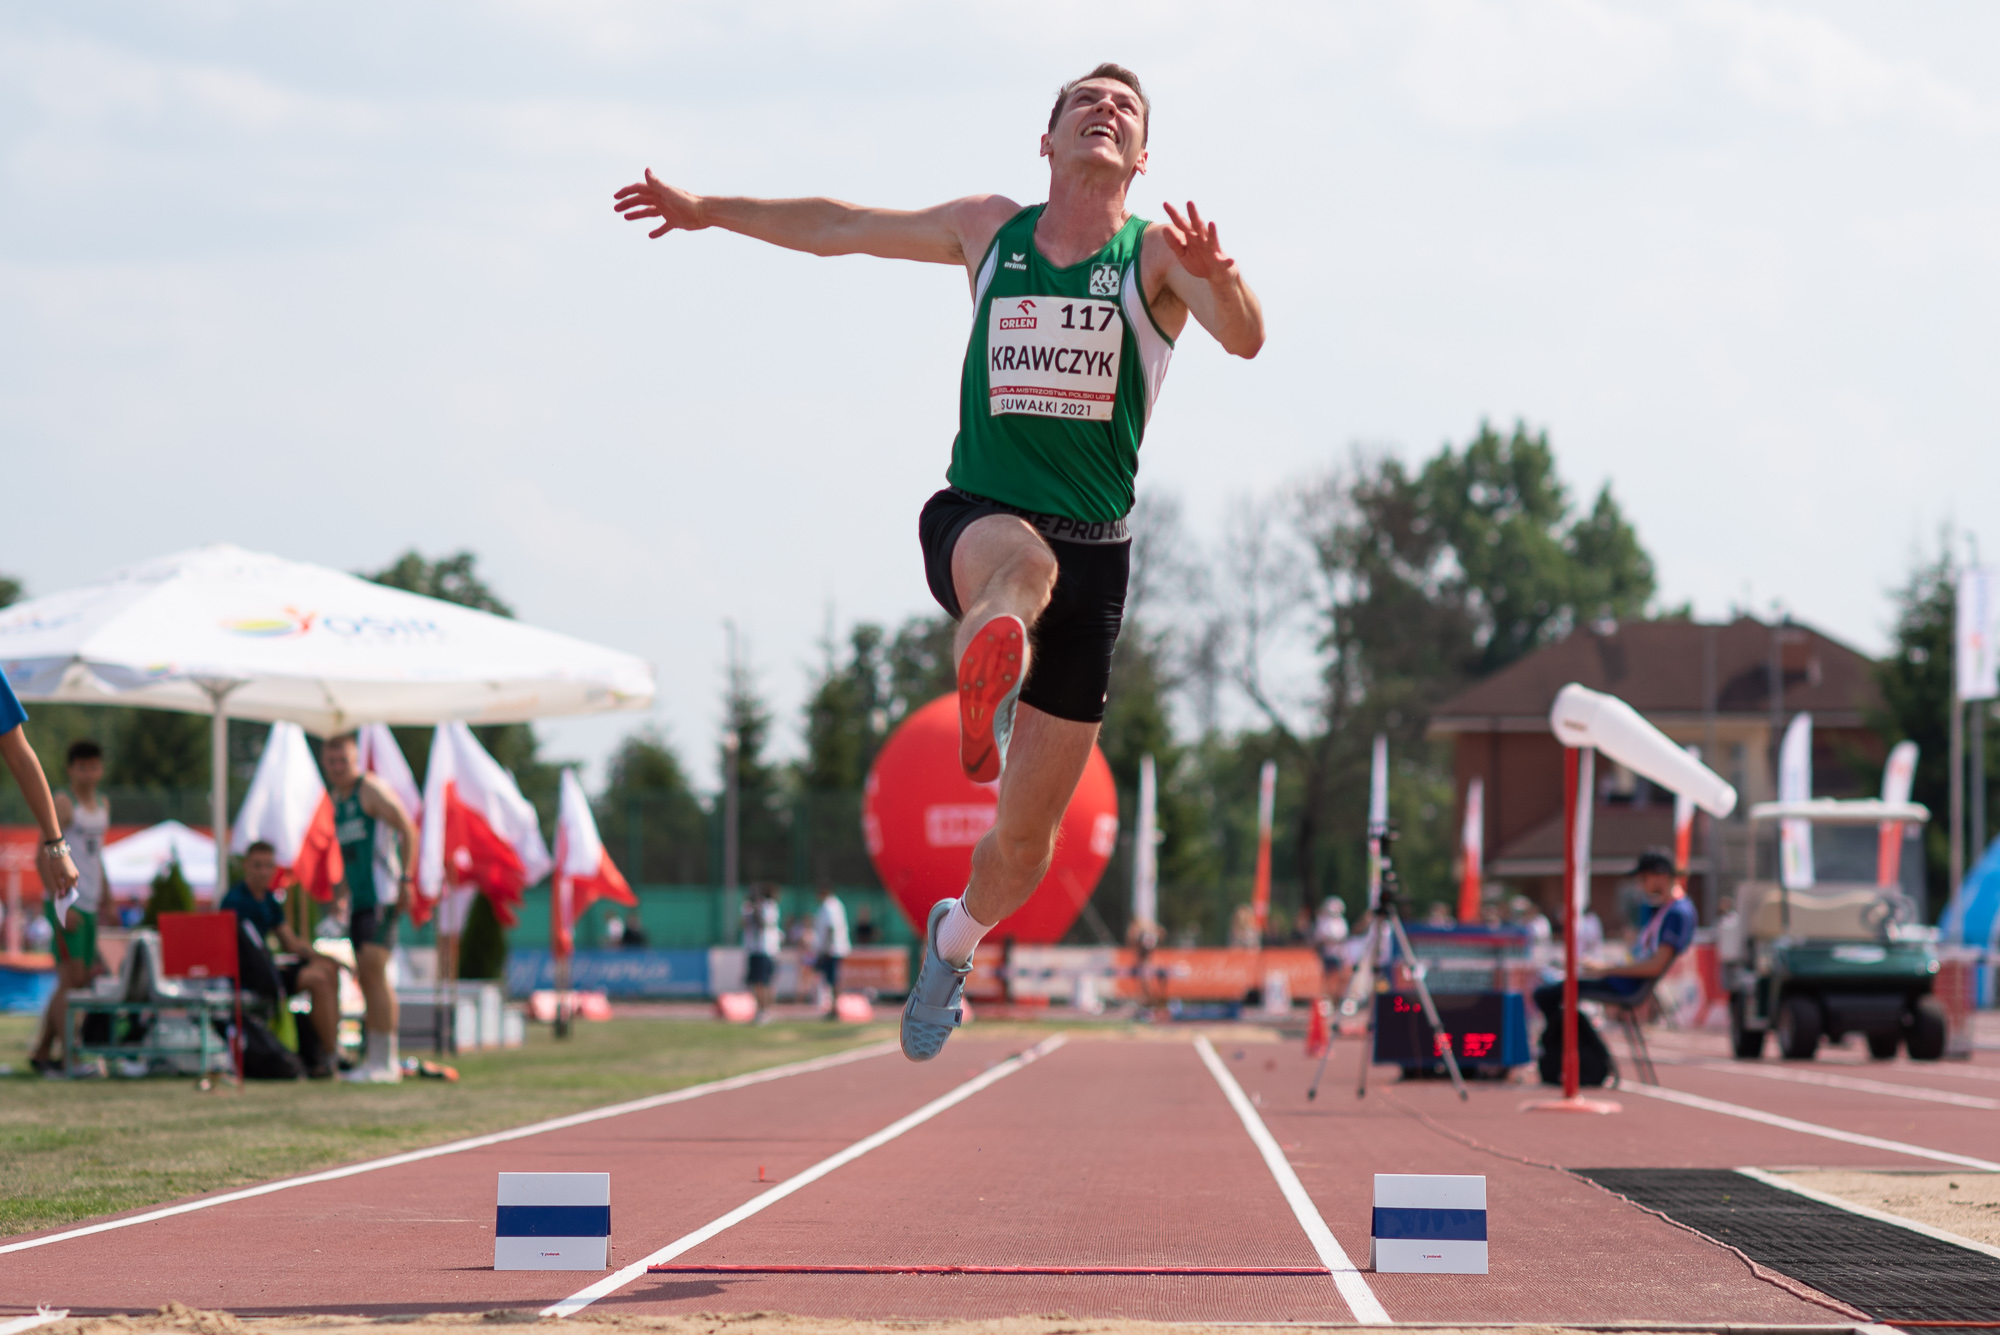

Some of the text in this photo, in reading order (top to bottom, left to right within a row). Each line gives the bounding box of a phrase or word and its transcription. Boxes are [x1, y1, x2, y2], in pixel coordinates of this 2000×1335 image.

[1004, 261, 1027, 271] erima
[1001, 318, 1036, 329] ORLEN
[1060, 304, 1116, 332] 117
[991, 345, 1114, 377] KRAWCZYK
[1016, 387, 1067, 397] MISTRZOSTWA
[1068, 391, 1095, 400] POLSKI
[1000, 398, 1092, 416] SUWAŁKI 2021
[1053, 516, 1104, 540] PRO
